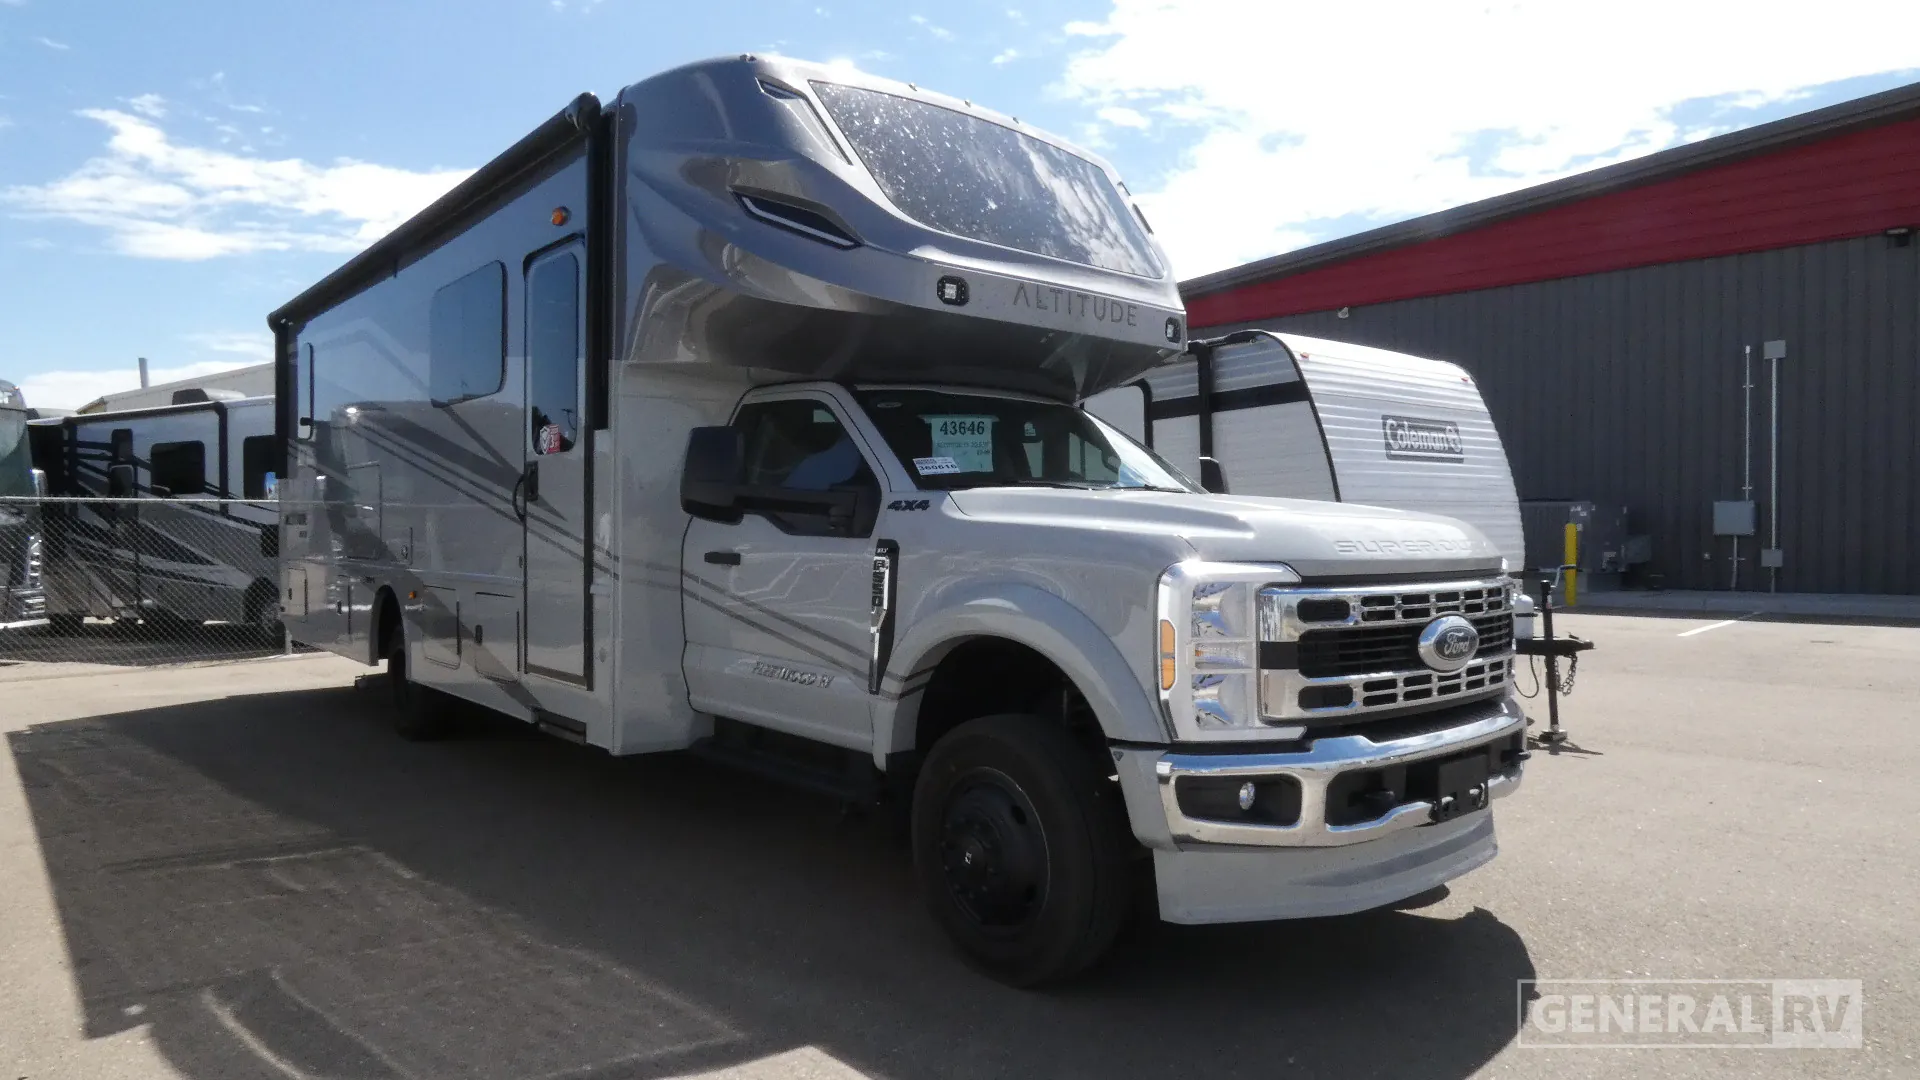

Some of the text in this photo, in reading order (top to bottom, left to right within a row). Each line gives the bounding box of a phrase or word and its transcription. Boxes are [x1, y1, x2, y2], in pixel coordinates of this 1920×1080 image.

[1013, 282, 1138, 327] ALTITUDE
[940, 421, 985, 436] 43646
[1386, 418, 1449, 451] Coleman
[1443, 631, 1472, 656] Ford
